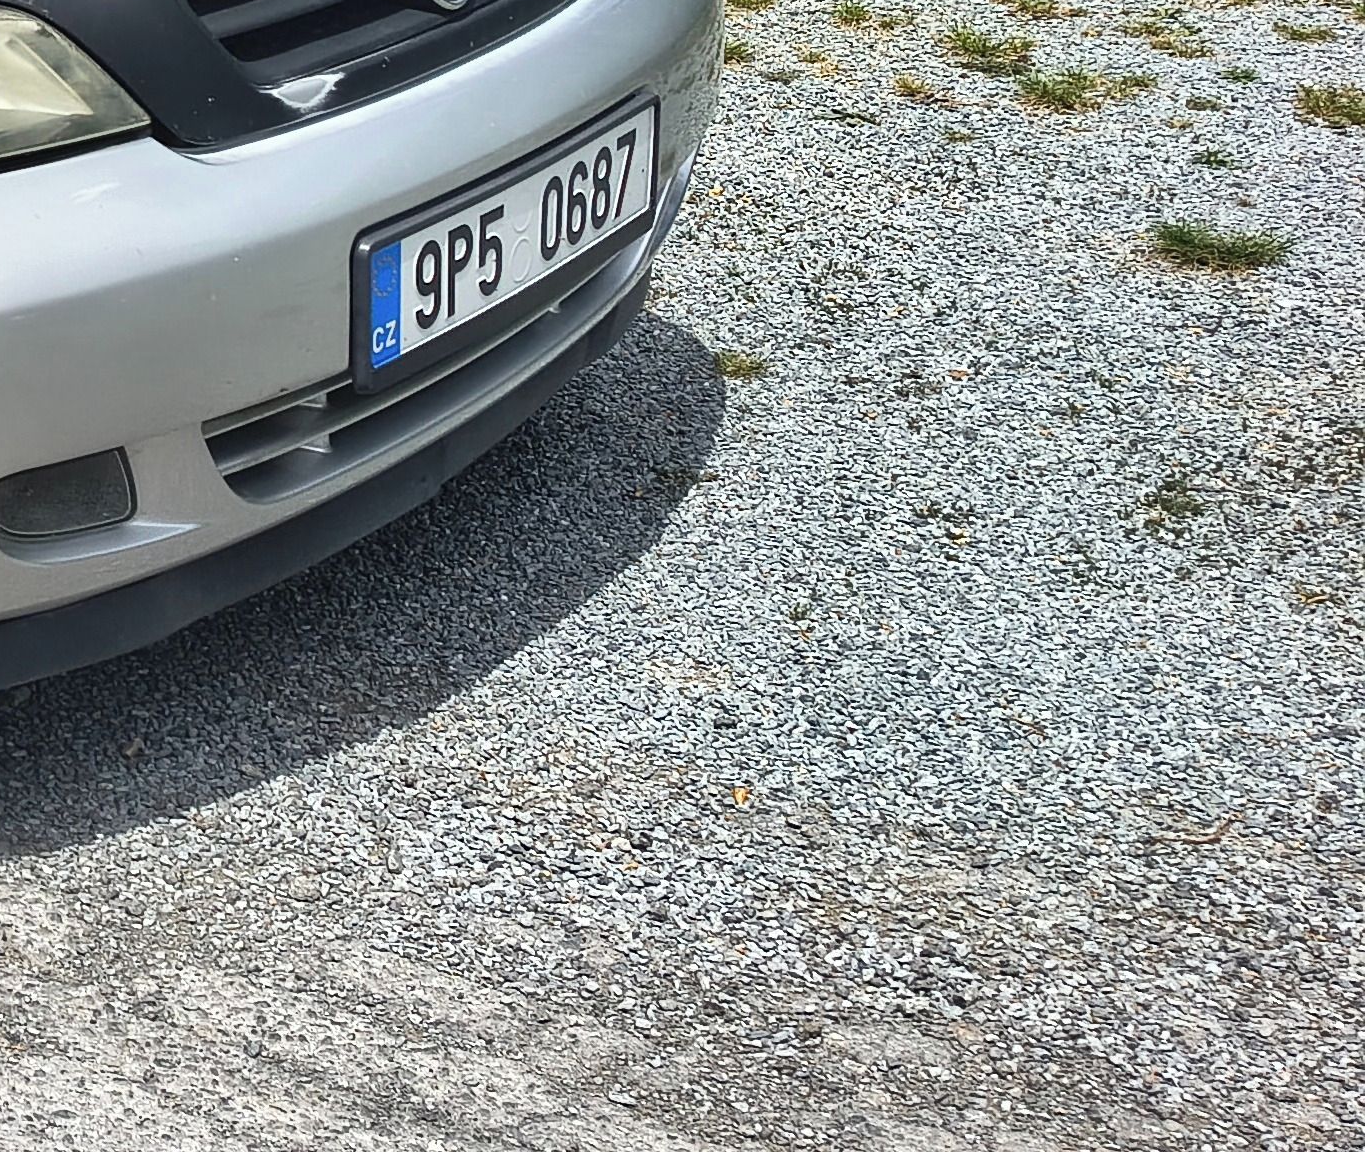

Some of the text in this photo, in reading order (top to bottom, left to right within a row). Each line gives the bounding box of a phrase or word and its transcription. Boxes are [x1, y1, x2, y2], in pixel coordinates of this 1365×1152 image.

[415, 127, 638, 330] 9P5 0687
[371, 318, 398, 354] CZ
